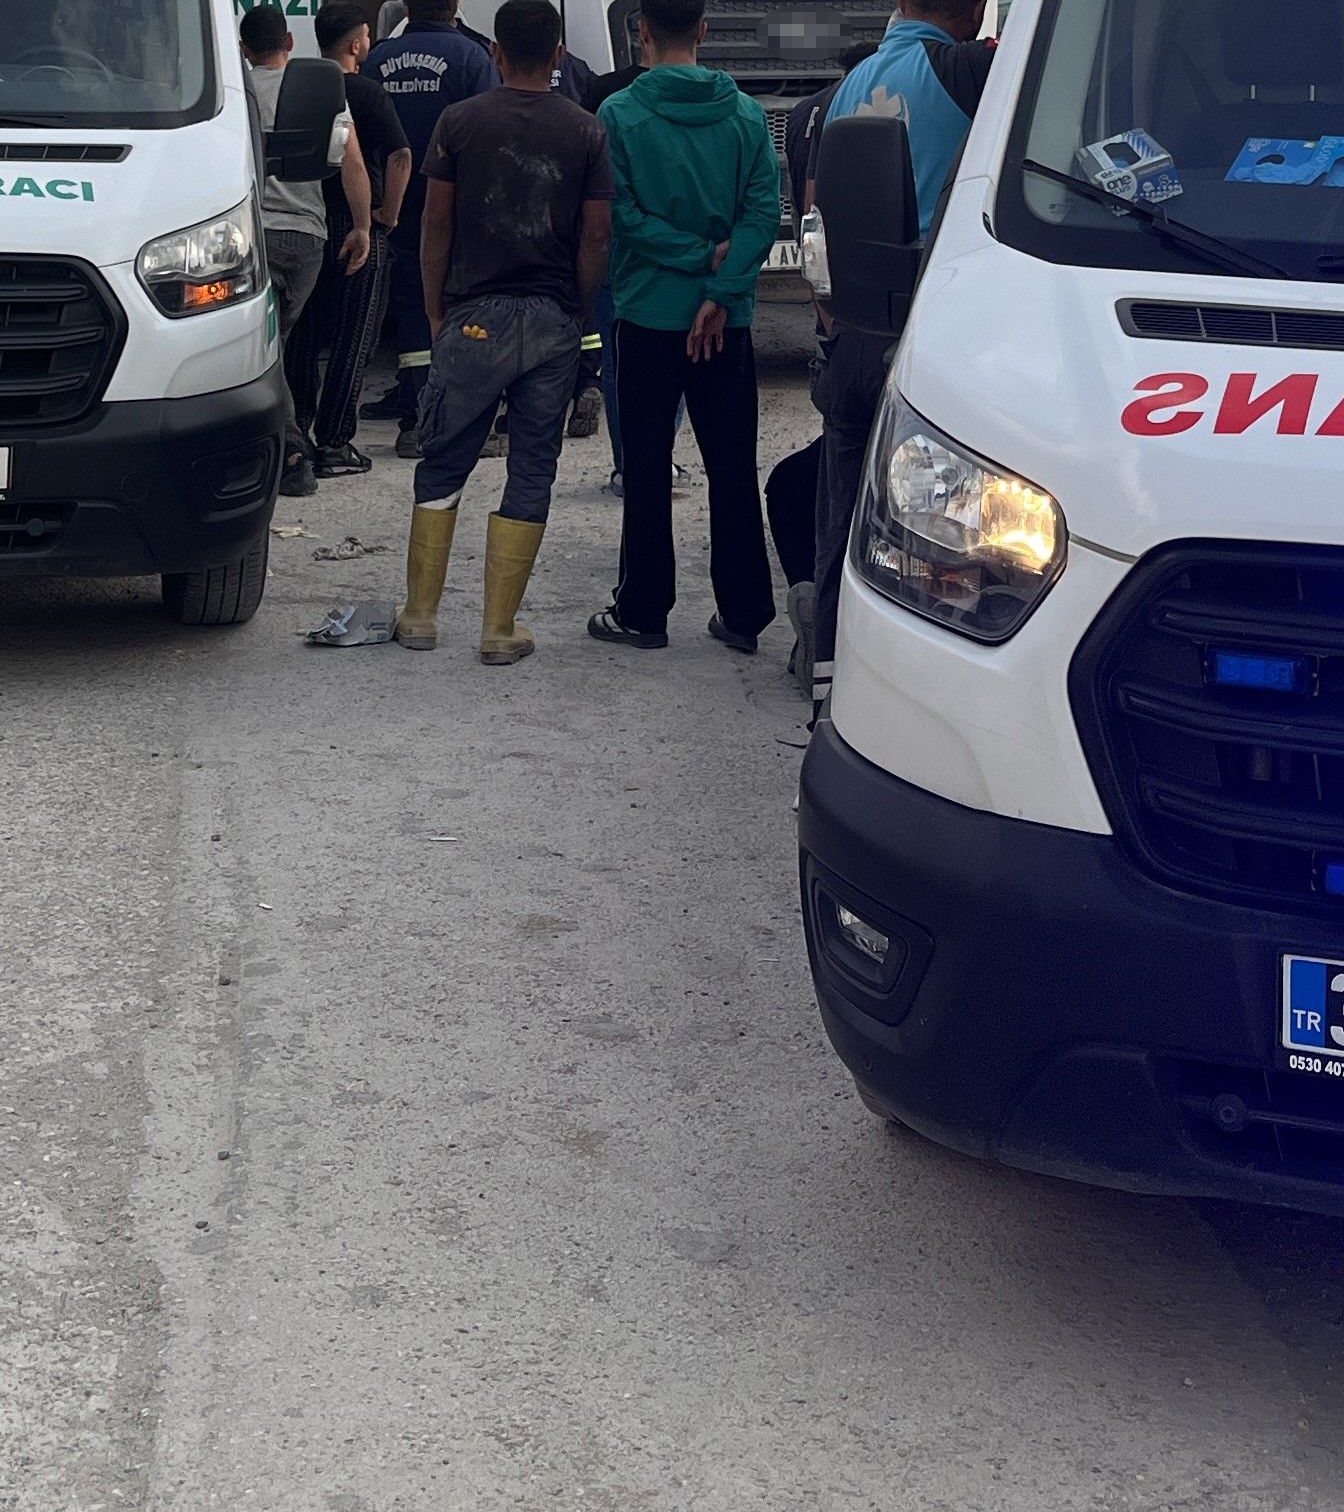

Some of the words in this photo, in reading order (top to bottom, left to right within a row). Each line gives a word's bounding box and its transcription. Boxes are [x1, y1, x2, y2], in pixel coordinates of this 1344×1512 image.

[379, 51, 448, 79] BÜYÜKŞEHİR
[1292, 1009, 1322, 1033] TR
[1289, 1054, 1322, 1073] 0530
